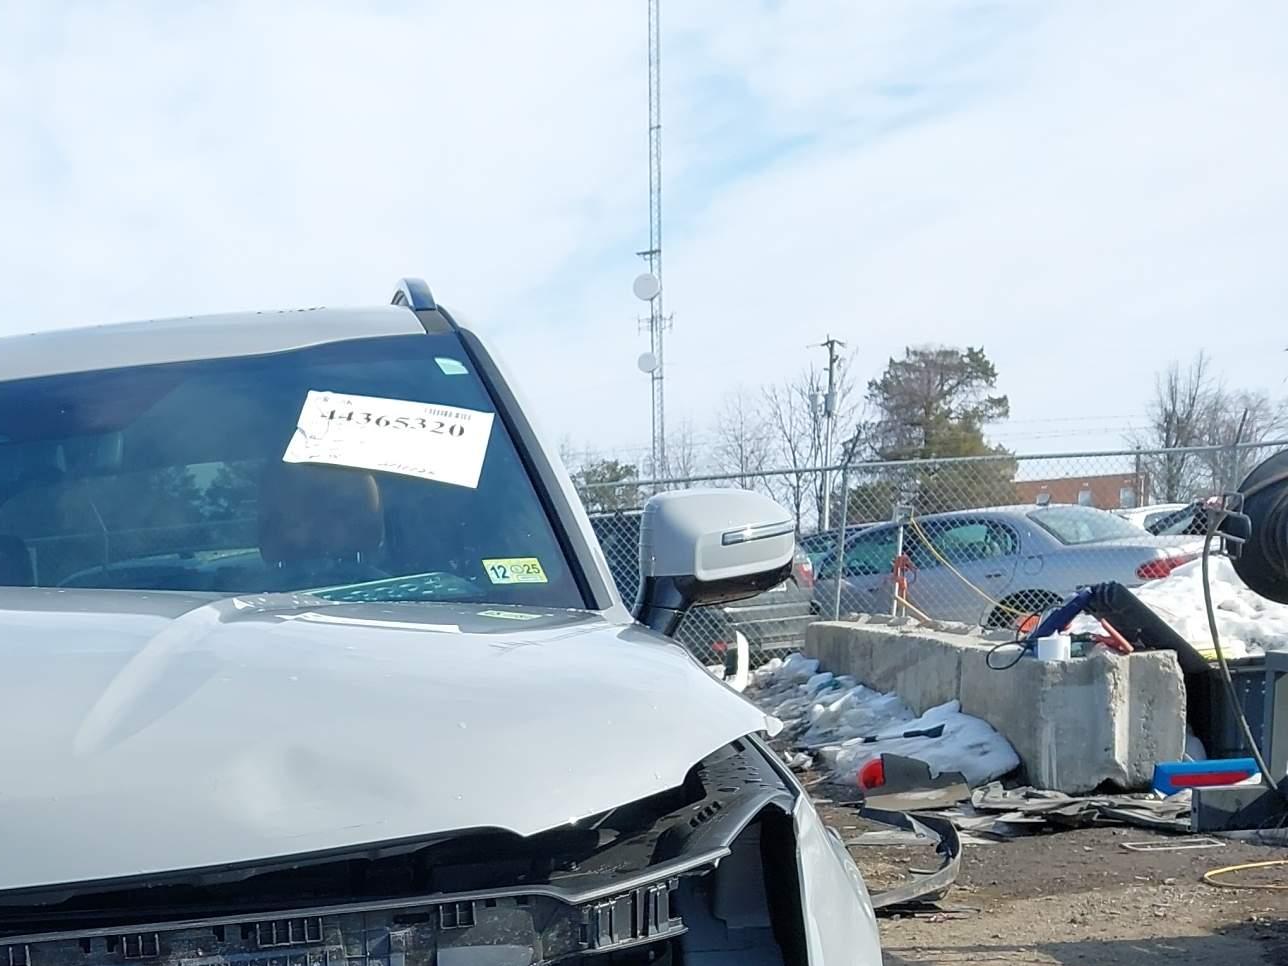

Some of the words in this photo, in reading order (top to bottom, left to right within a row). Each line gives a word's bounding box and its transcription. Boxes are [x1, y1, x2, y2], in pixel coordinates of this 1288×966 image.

[319, 409, 465, 437] 44365320
[490, 565, 510, 579] 12
[523, 563, 540, 574] 25
